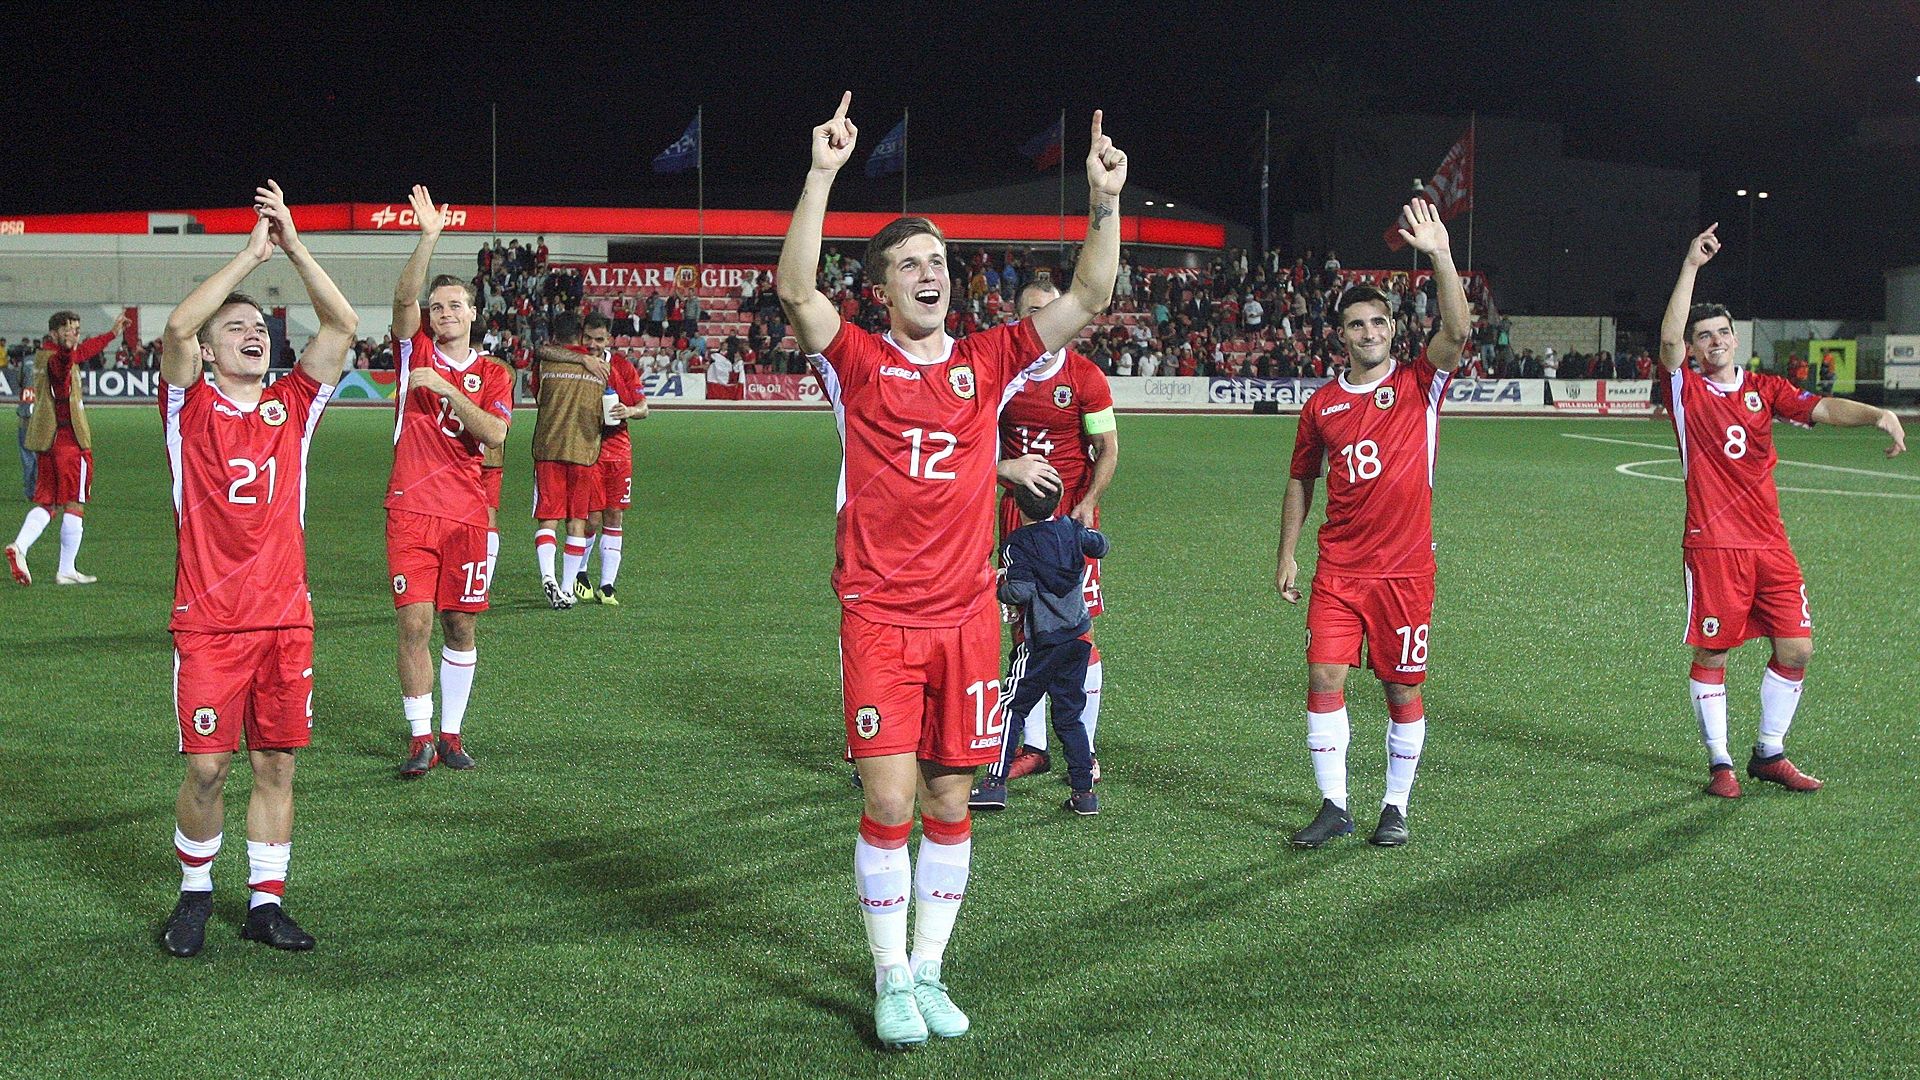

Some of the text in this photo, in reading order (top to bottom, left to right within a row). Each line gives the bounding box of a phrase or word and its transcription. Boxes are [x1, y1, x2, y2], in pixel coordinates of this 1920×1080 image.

[0, 221, 25, 234] PSA
[399, 209, 467, 227] CSA
[880, 365, 921, 380] LEGEA
[1144, 378, 1191, 400] Callaghan
[1321, 402, 1351, 417] LEGEA
[901, 427, 958, 480] 12
[1015, 427, 1055, 456] 14
[1723, 424, 1747, 460] 8
[1340, 439, 1382, 484] 18
[227, 456, 277, 505] 21
[461, 560, 487, 596] 15
[1395, 623, 1429, 665] 18
[965, 679, 1003, 737] 12
[932, 889, 965, 901] LEG
